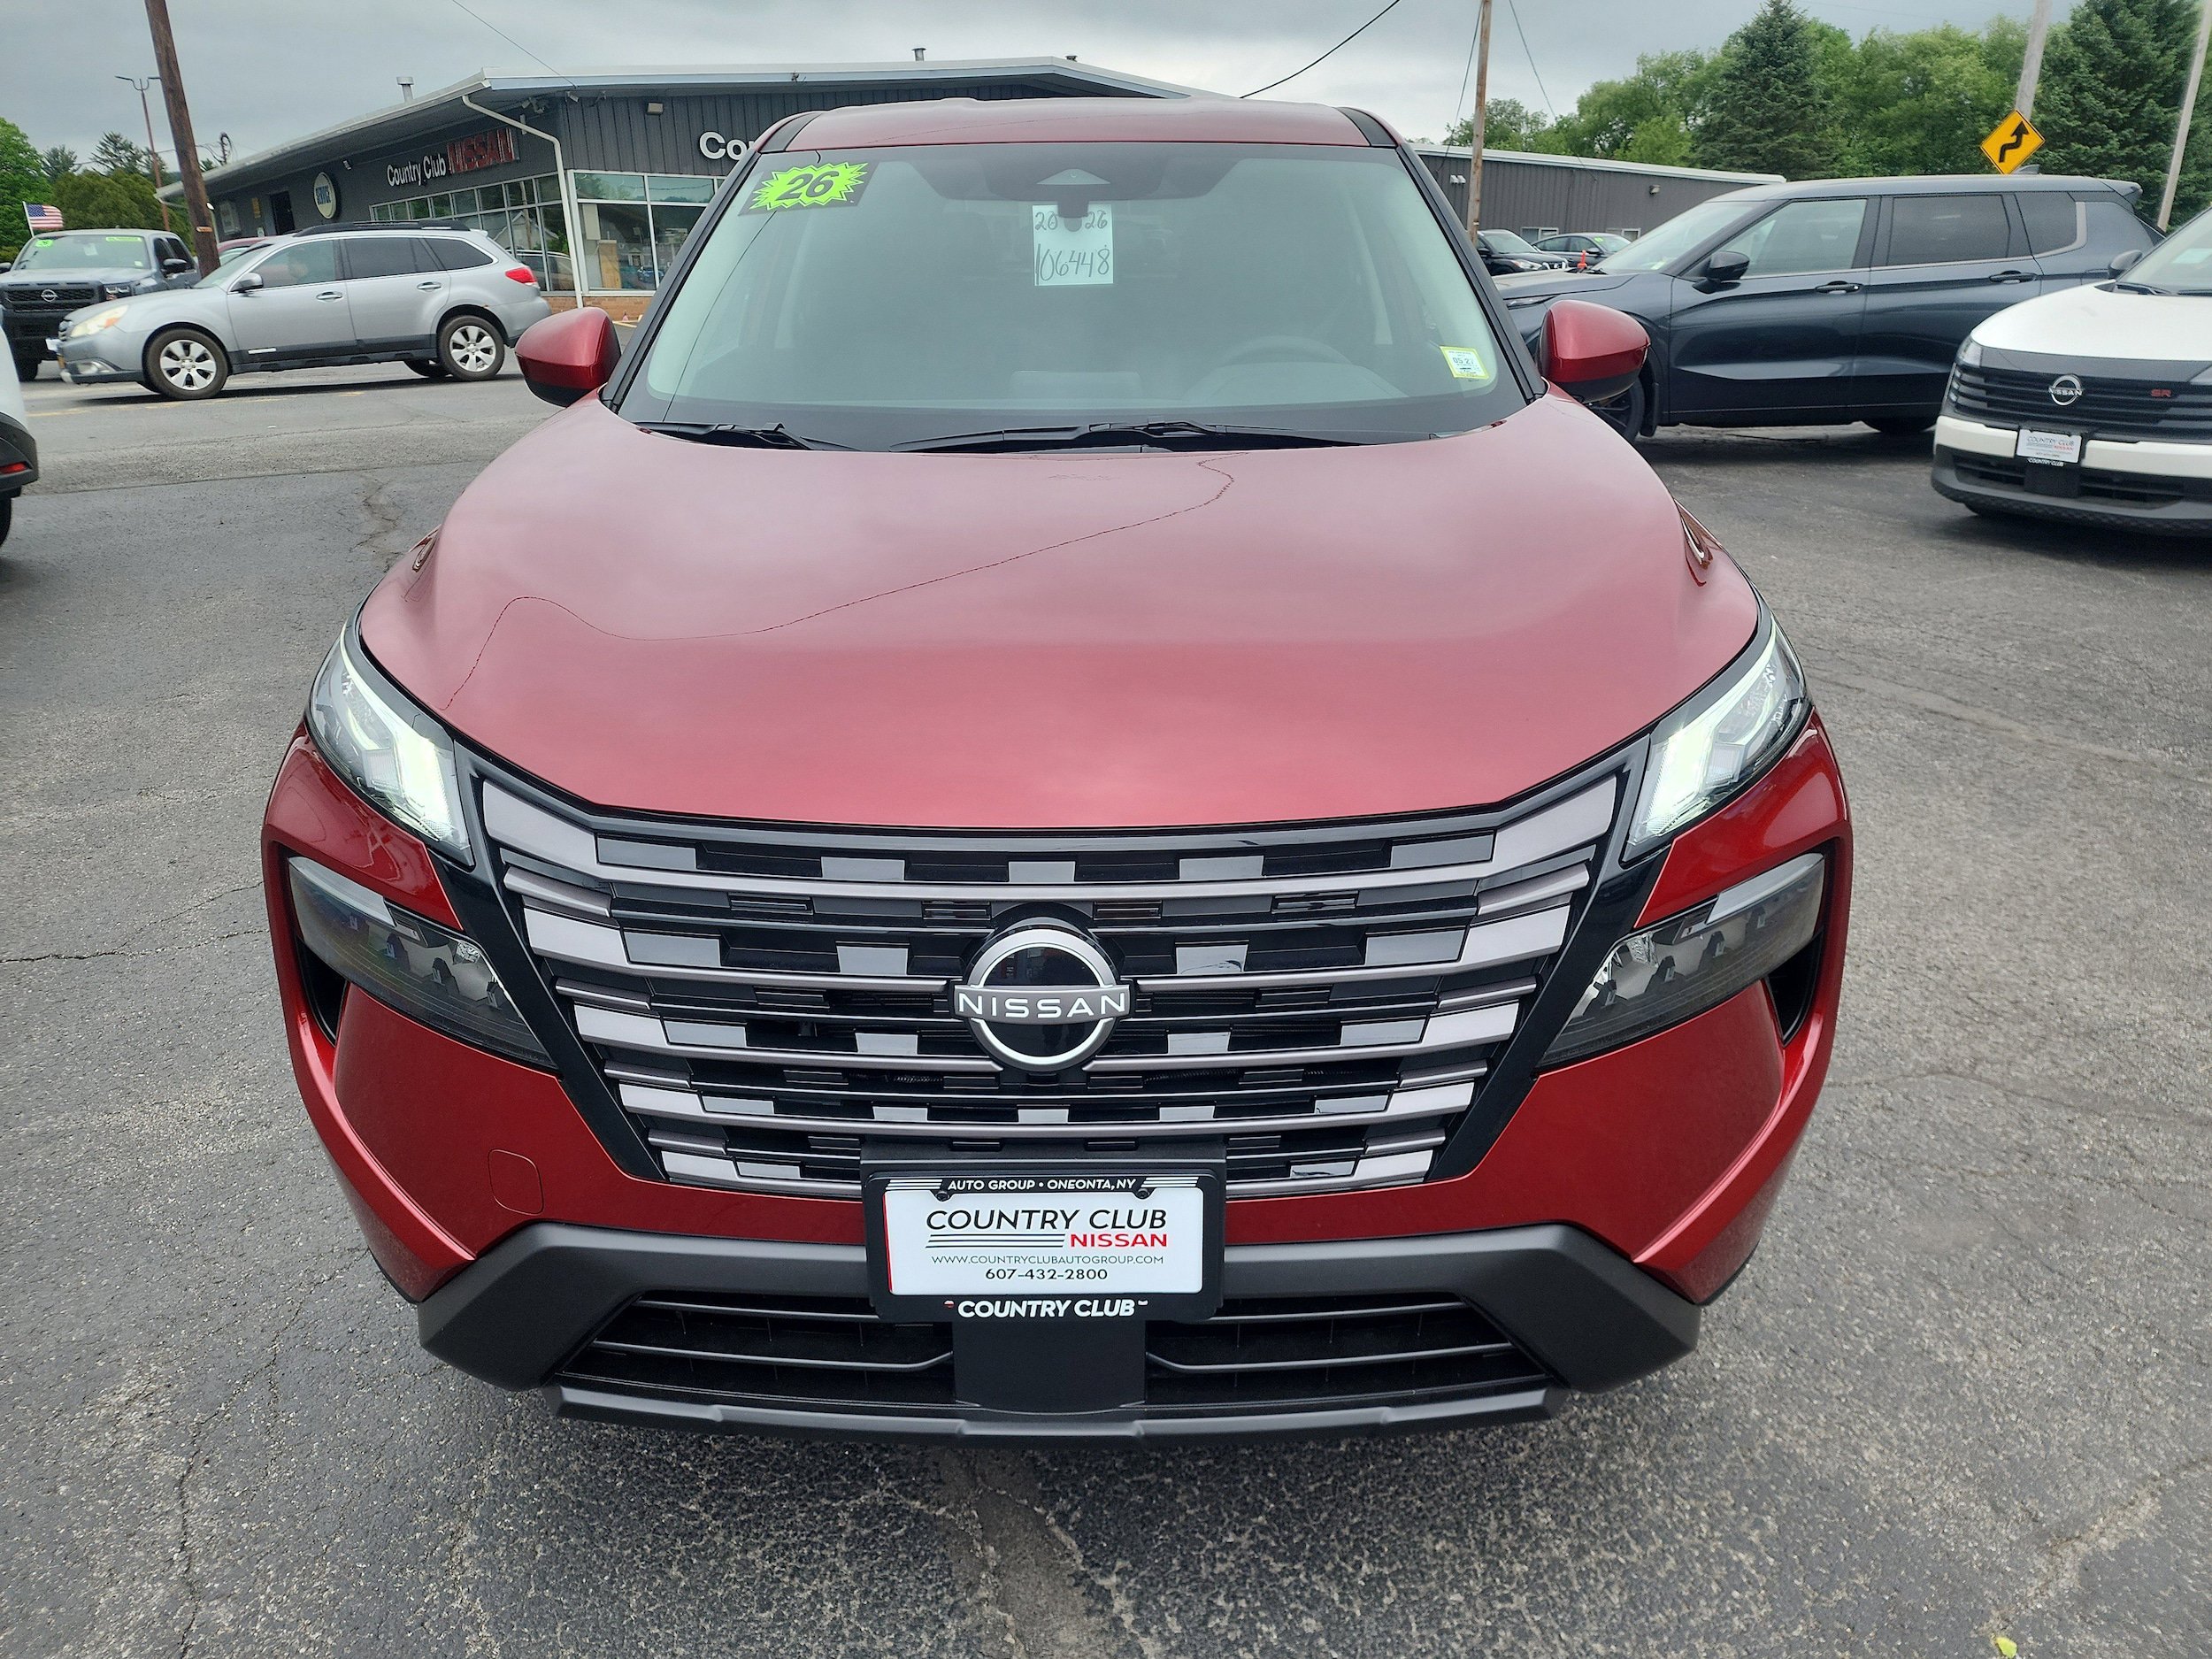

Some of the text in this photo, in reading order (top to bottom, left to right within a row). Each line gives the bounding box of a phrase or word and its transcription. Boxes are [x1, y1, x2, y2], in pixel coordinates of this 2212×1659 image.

[387, 127, 516, 187] Country Club NISSAN
[774, 170, 840, 202] 26
[1085, 210, 1108, 229] 26
[2048, 386, 2083, 396] NISSAN
[2151, 388, 2172, 397] SR
[958, 992, 1125, 1018] NISSAN
[948, 1179, 985, 1191] AUTO
[987, 1179, 1036, 1190] GROUP
[926, 1209, 1167, 1231] COUNTRY CLUB
[1070, 1233, 1168, 1248] NISSAN
[932, 1255, 1164, 1264] WWW.COUNTRYCLUBAUTOGROUP.COM
[985, 1268, 1109, 1280] 607-432-2800
[957, 1298, 1136, 1318] COUNTRY CLUB
